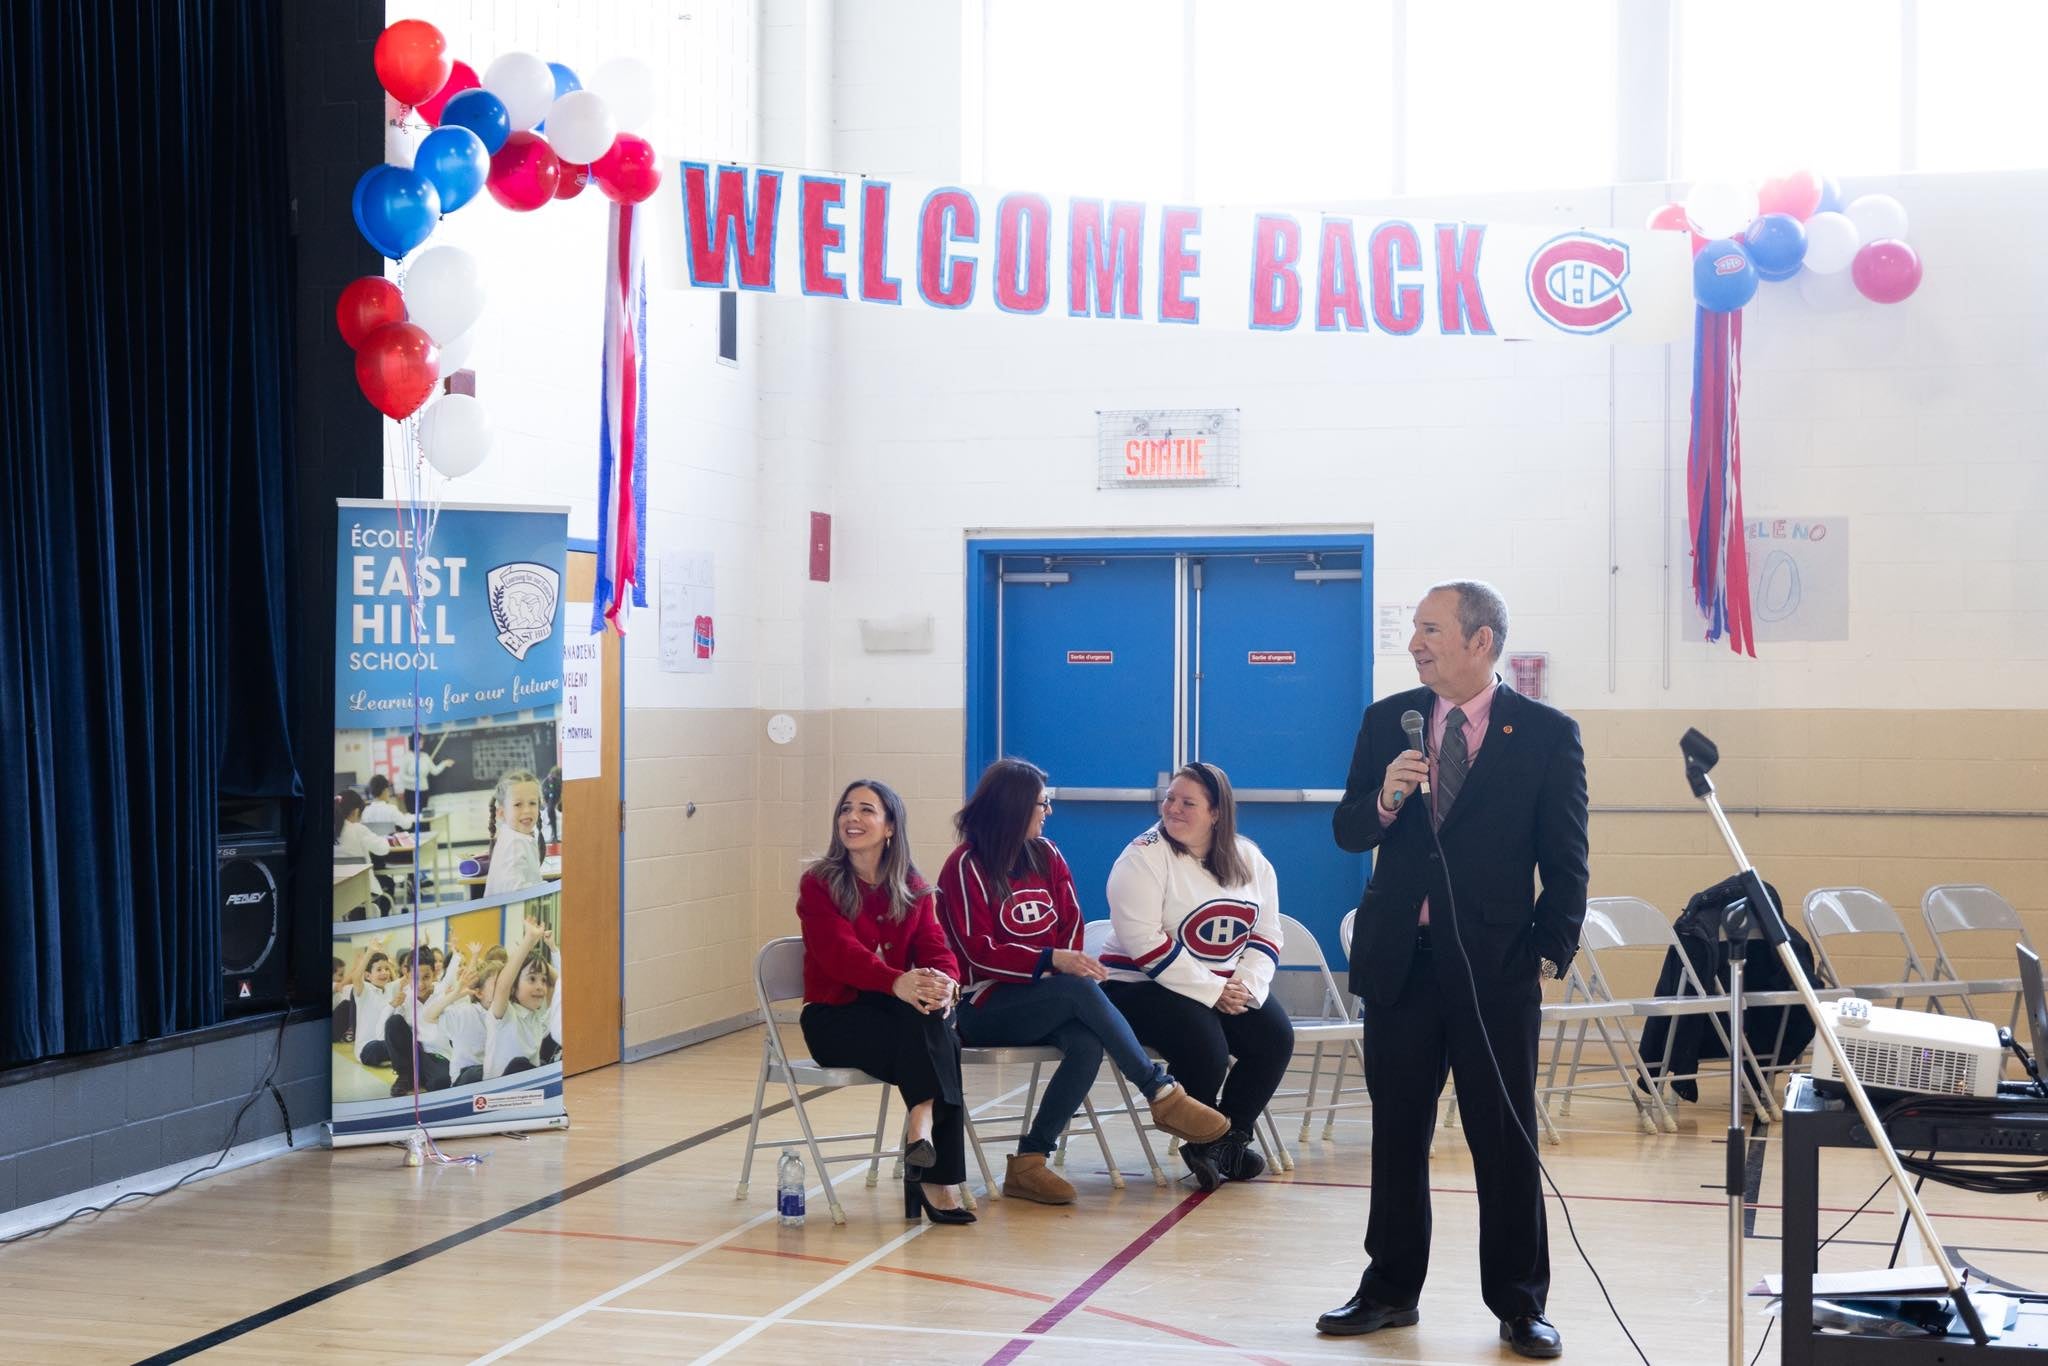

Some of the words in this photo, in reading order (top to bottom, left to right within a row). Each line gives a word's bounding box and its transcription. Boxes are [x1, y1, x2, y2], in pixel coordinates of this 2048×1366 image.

[680, 160, 1202, 324] WELCOME
[1249, 211, 1497, 336] BACK
[1125, 438, 1206, 477] SORTIE
[351, 523, 414, 548] ÉCOLE
[1745, 519, 1827, 541] ELENO
[353, 556, 467, 597] EAST
[352, 604, 456, 644] HILL
[349, 652, 439, 671] SCHOOL
[563, 643, 596, 660] ANADIENS
[349, 690, 435, 714] Learning
[443, 684, 469, 712] for
[475, 687, 505, 702] our
[512, 675, 559, 704] future
[226, 892, 266, 906] PEAVEY
